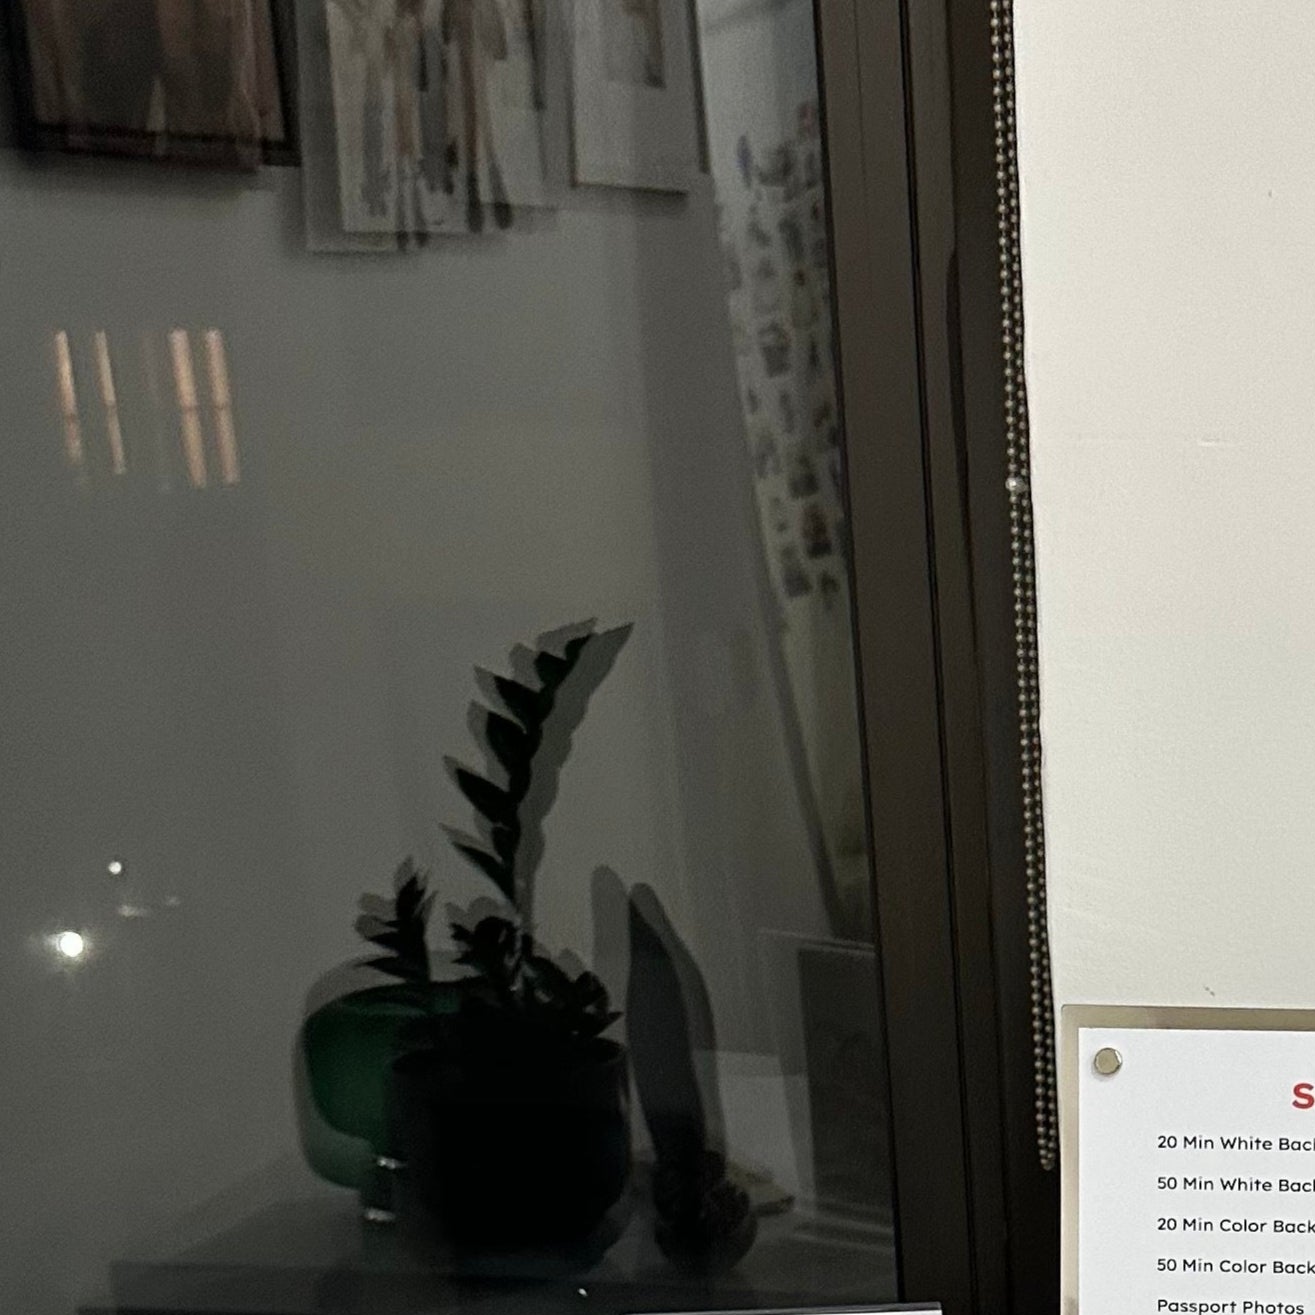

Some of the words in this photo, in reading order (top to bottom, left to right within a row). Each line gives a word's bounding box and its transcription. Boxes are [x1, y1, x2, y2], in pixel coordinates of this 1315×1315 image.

[1157, 1135, 1178, 1149] 20
[1183, 1135, 1215, 1150] Min
[1219, 1136, 1273, 1151] White
[1157, 1176, 1178, 1190] 50
[1183, 1177, 1214, 1191] Min
[1219, 1177, 1273, 1192] White
[1157, 1217, 1178, 1231] 20
[1182, 1218, 1214, 1232] Min
[1219, 1218, 1268, 1233] Color
[1157, 1258, 1177, 1272] 50
[1182, 1258, 1214, 1273] Min
[1219, 1259, 1267, 1274] Color
[1158, 1300, 1236, 1315] Passport
[1243, 1301, 1304, 1315] Photos
